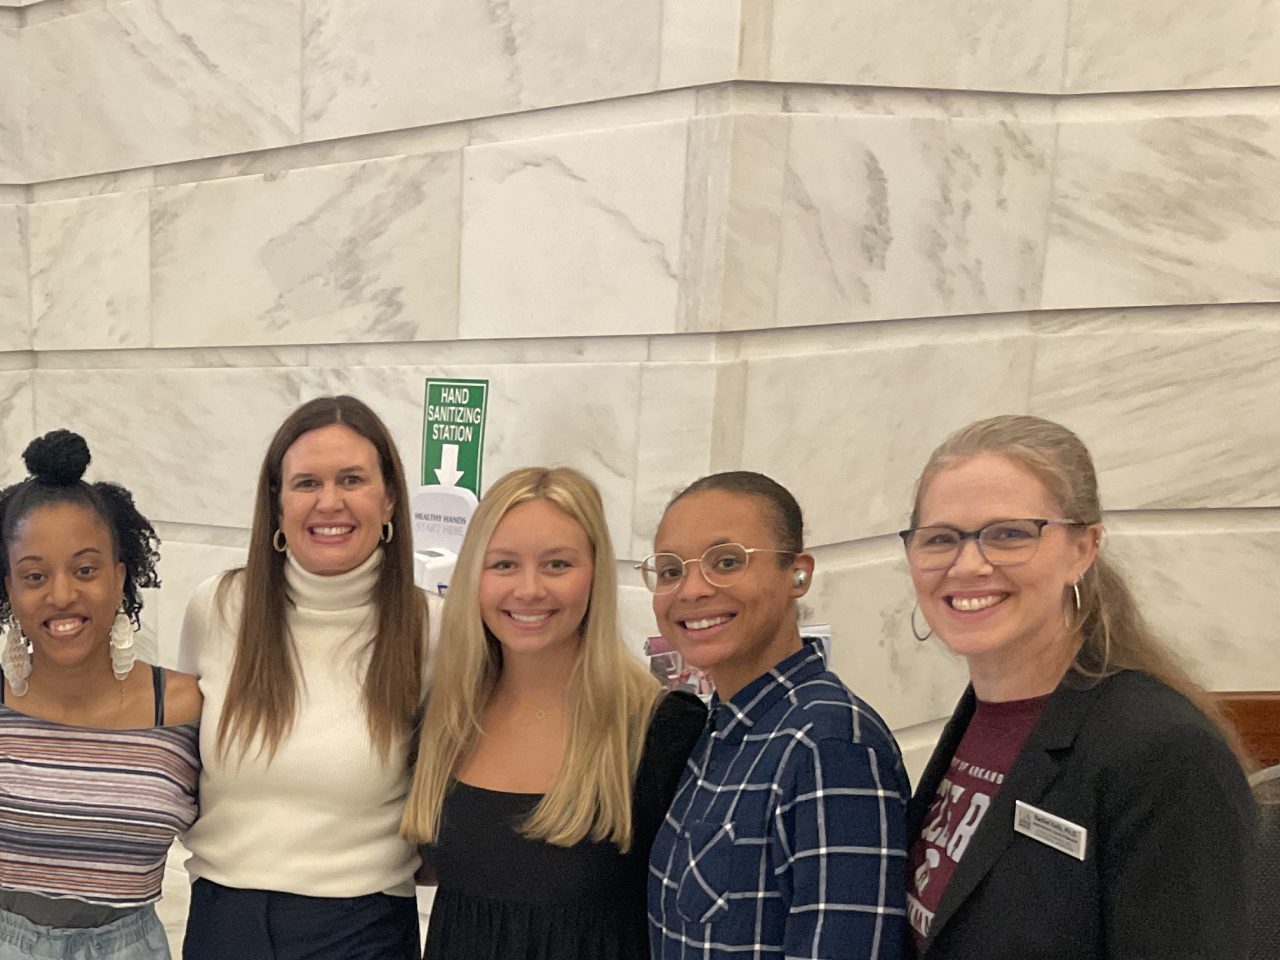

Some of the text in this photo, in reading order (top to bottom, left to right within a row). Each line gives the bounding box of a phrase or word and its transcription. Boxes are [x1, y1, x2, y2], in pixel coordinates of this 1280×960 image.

[441, 388, 469, 404] HAND
[428, 405, 481, 424] SANITIZING
[432, 424, 473, 442] STATION
[414, 512, 467, 525] HEALTHY HANDS
[416, 522, 464, 537] START HERE
